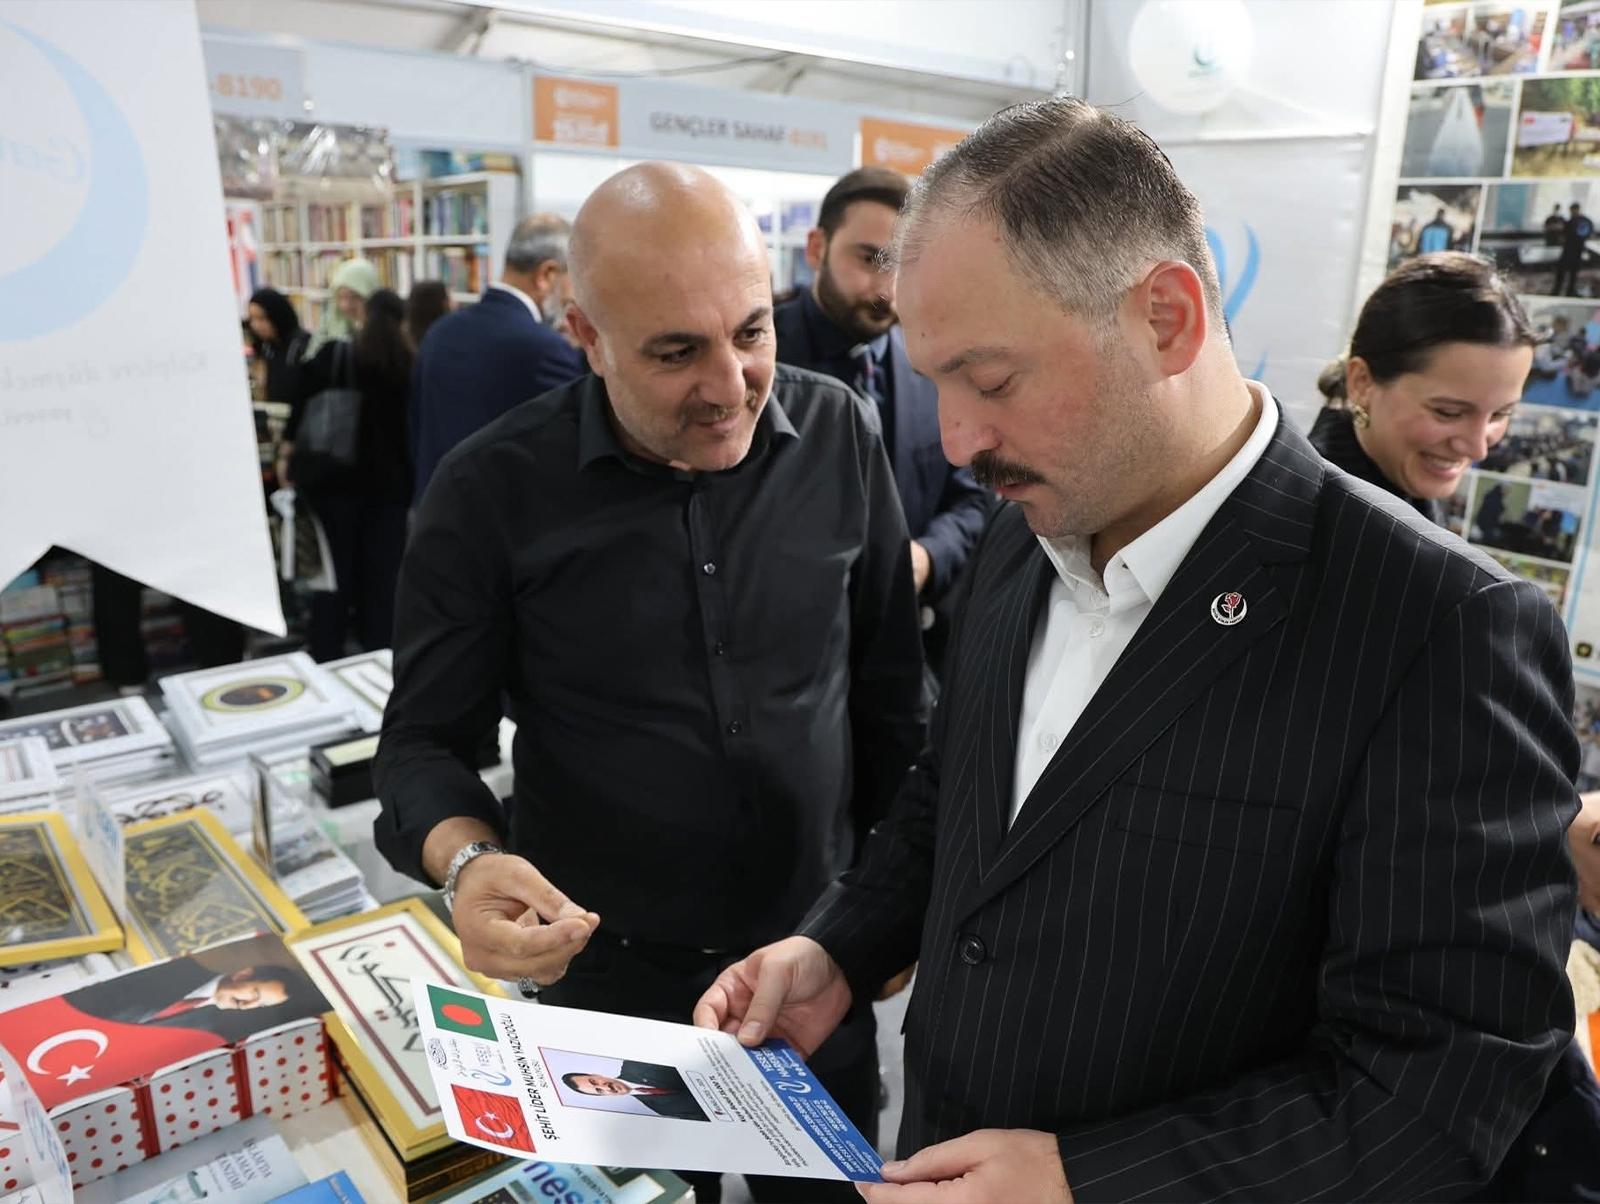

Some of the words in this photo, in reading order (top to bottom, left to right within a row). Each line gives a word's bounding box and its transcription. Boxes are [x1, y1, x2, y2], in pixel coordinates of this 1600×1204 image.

[499, 1012, 524, 1055] YAZICIOĞLU
[513, 1055, 537, 1088] MUHSİN
[526, 1088, 547, 1113] LİDER
[535, 1114, 560, 1140] ŞEHİT
